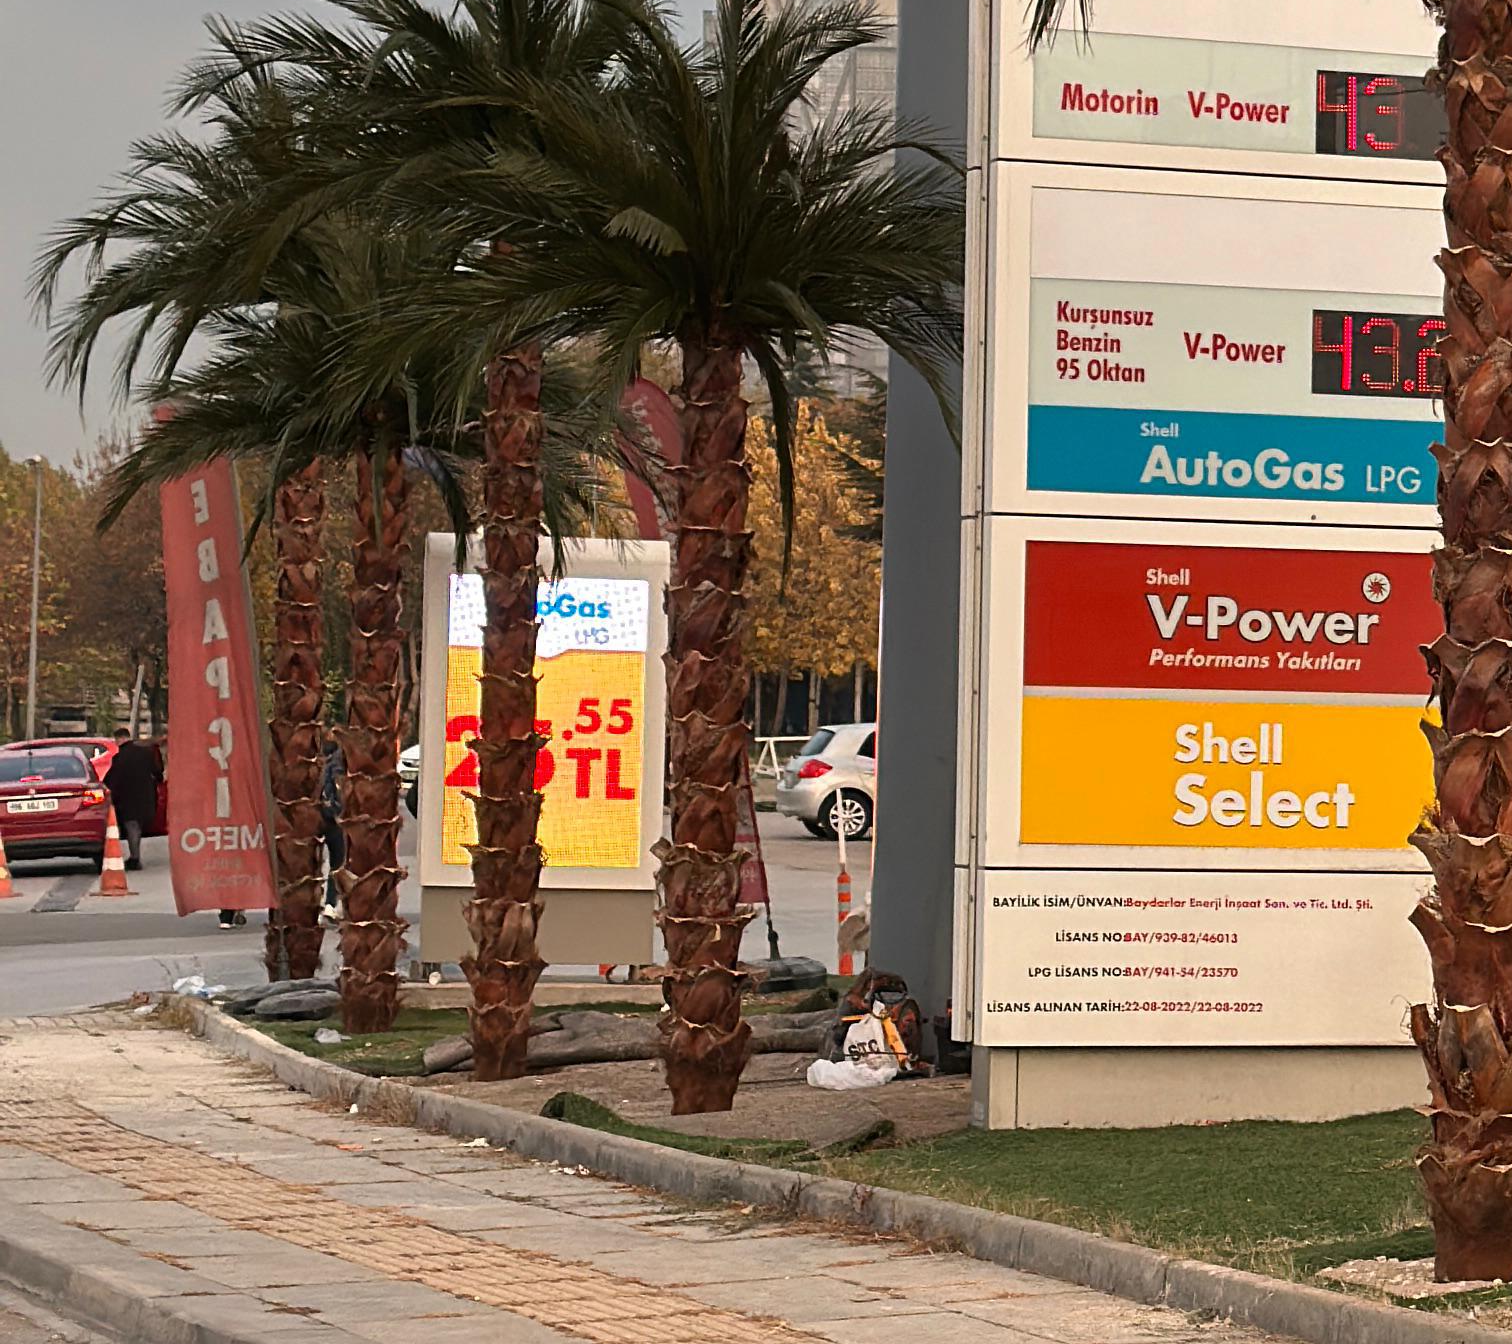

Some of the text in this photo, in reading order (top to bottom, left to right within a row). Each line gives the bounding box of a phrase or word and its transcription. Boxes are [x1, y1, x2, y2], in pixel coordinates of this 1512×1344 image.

[1060, 83, 1159, 116] Motorin
[1188, 90, 1290, 124] V-Power
[1056, 301, 1154, 329] Kurşunsuz
[1056, 330, 1121, 353] Benzin
[1183, 331, 1286, 364] V-Power
[1056, 359, 1145, 383] 95 Oktan
[1140, 422, 1179, 438] Shell
[1140, 444, 1422, 494] AutoGas LPG
[1146, 568, 1191, 586] Shell
[536, 593, 611, 619] oGas
[1146, 593, 1380, 645] V-Power
[1149, 648, 1361, 671] Performans Yakıtları
[1174, 722, 1284, 765] Shell
[566, 747, 636, 801] TL
[1173, 770, 1356, 829] Select
[992, 895, 1040, 907] BAYİLİK
[1189, 897, 1222, 911] Enerji
[1331, 899, 1352, 910] Ltd.
[1356, 899, 1374, 912] Şti.
[1055, 929, 1099, 942] LİSANS
[1028, 967, 1051, 978] LPG
[1055, 965, 1099, 977] LİSANS
[986, 1000, 1031, 1013] LİSANS
[1034, 1002, 1082, 1013] ALINAN
